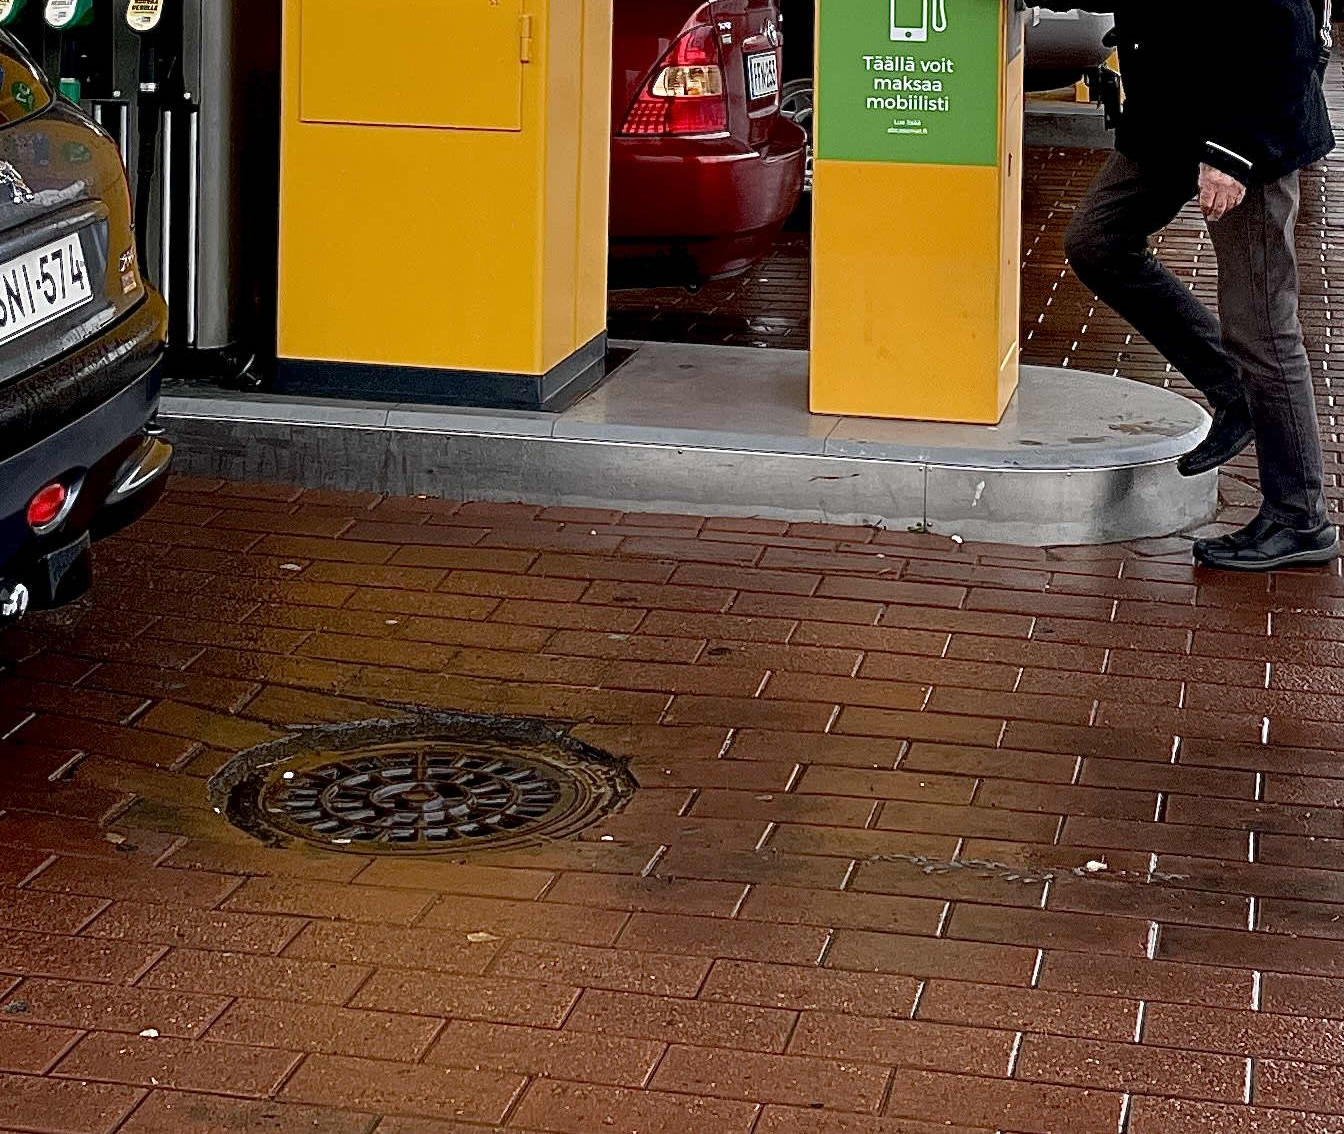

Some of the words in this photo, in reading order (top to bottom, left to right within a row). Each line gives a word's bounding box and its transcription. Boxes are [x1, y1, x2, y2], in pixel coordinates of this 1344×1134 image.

[862, 55, 916, 73] Täällä
[920, 57, 954, 73] voit
[874, 76, 942, 92] maksaa
[866, 94, 949, 112] mobiilisti
